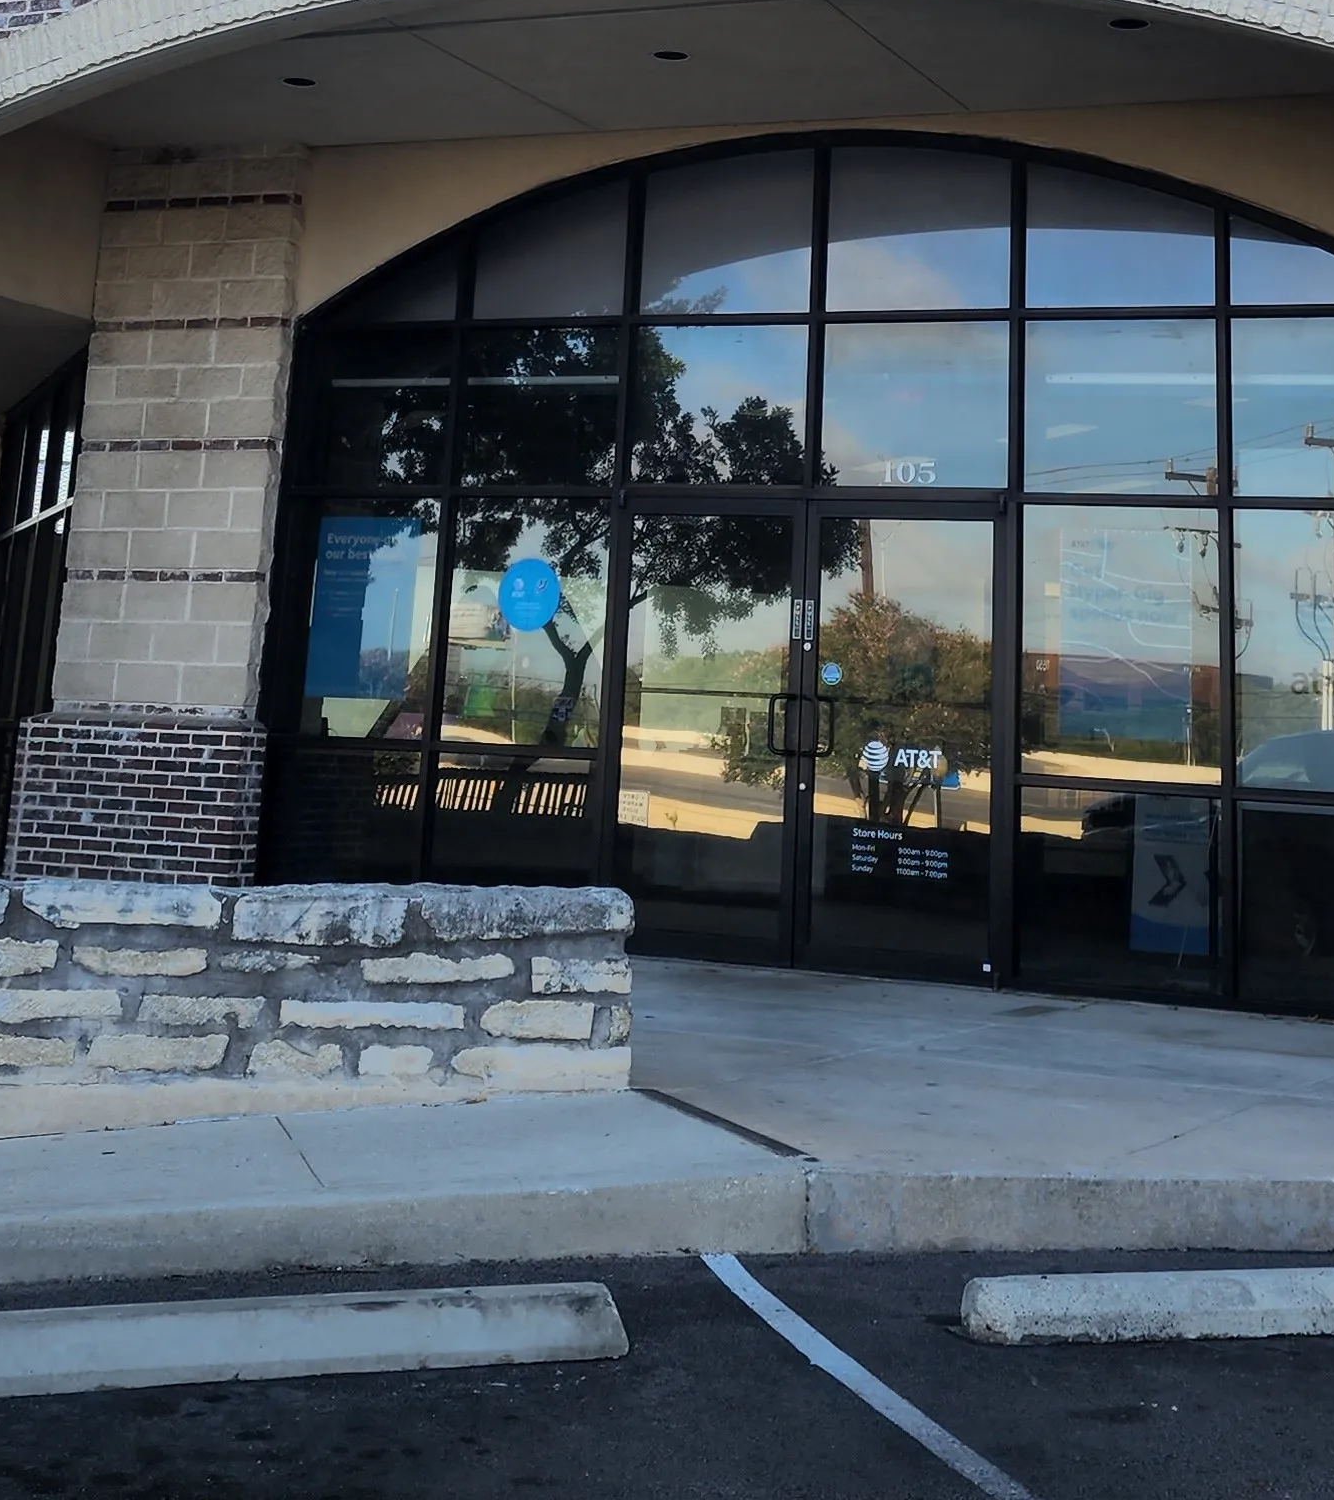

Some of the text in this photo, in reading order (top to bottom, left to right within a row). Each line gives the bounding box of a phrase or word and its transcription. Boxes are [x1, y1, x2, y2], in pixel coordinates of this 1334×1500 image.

[883, 461, 937, 484] 105
[894, 748, 943, 769] AT&T
[852, 827, 903, 841] Store Hours
